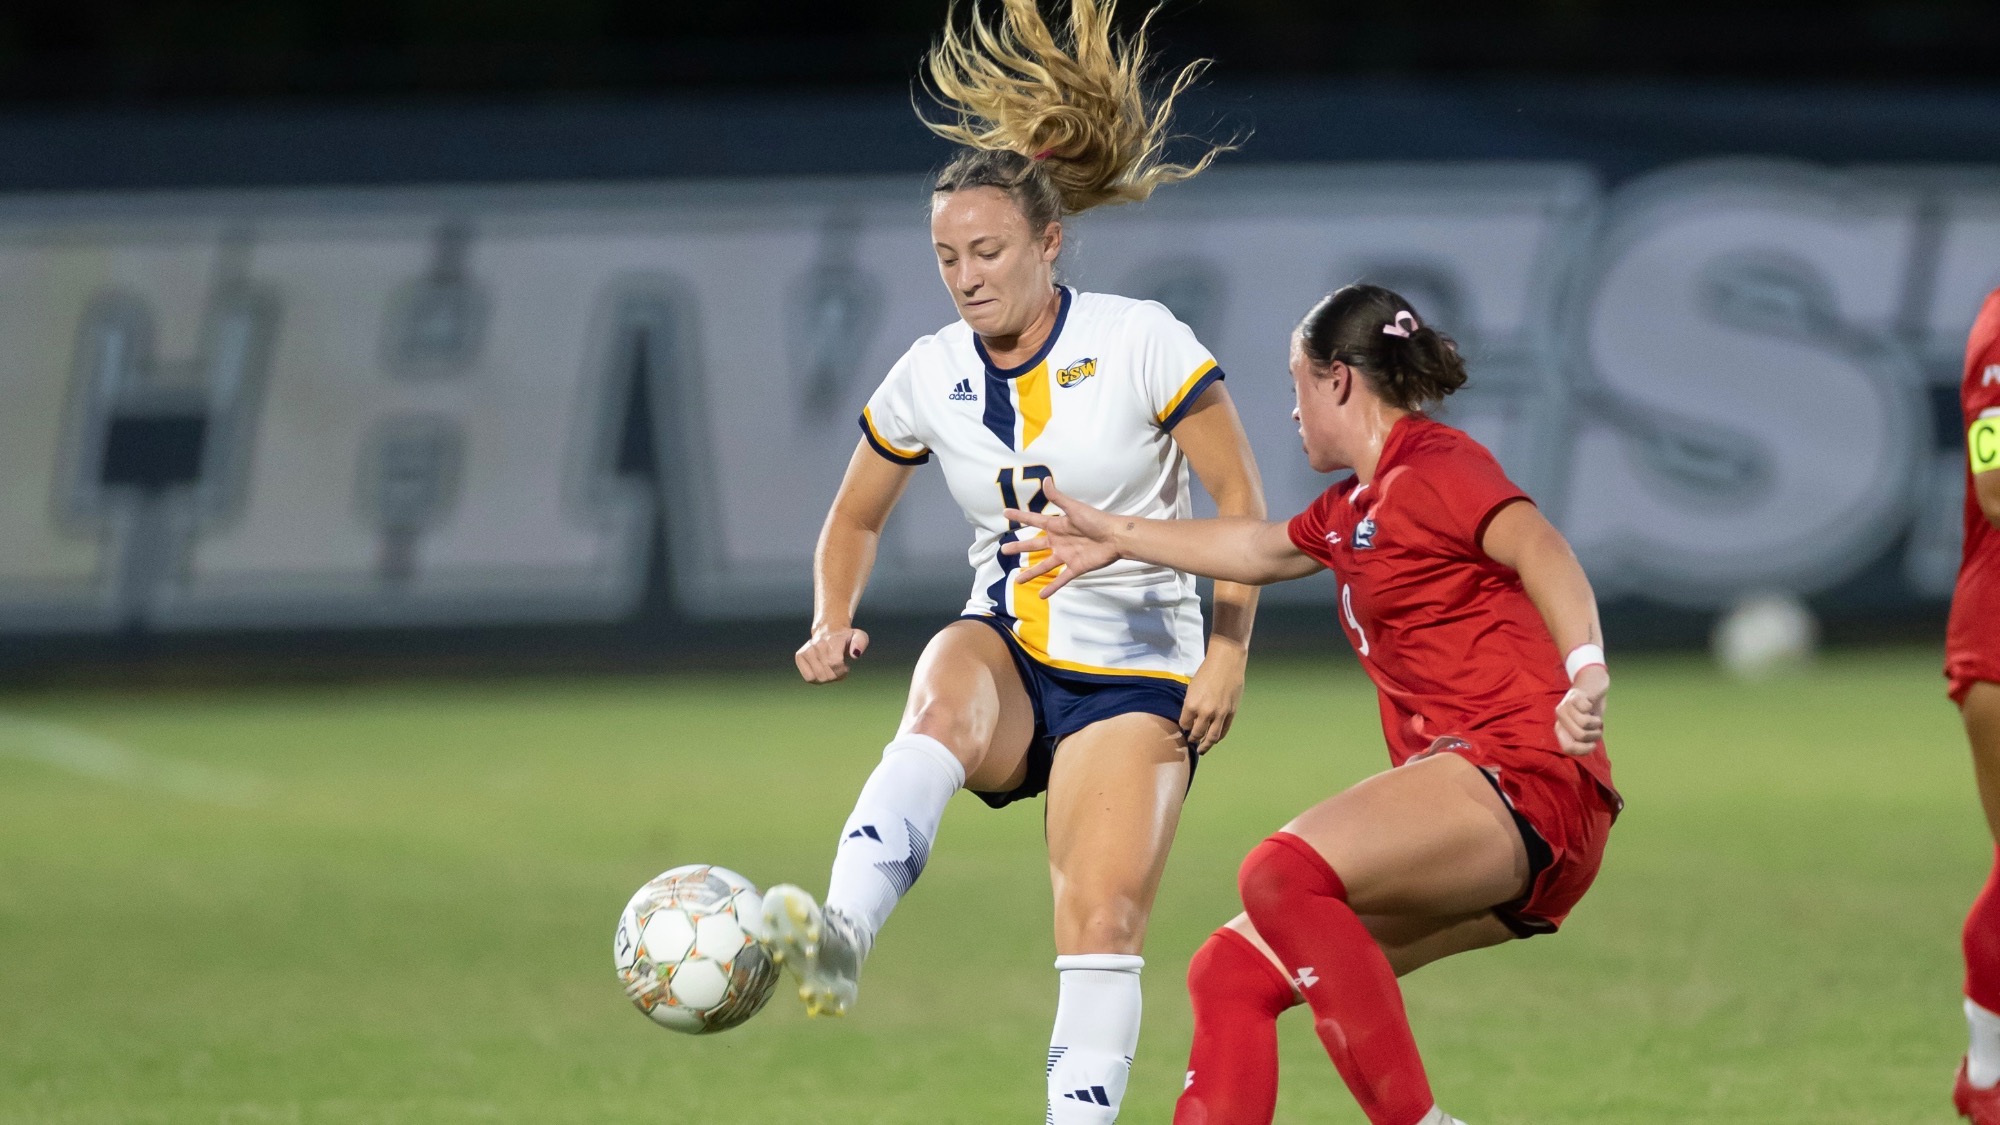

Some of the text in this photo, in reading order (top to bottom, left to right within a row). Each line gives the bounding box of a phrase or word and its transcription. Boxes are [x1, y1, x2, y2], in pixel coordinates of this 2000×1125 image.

[1056, 358, 1098, 387] GSW
[949, 392, 978, 401] adidas
[1977, 427, 1996, 463] C
[995, 465, 1061, 531] 12
[1342, 583, 1370, 656] 9
